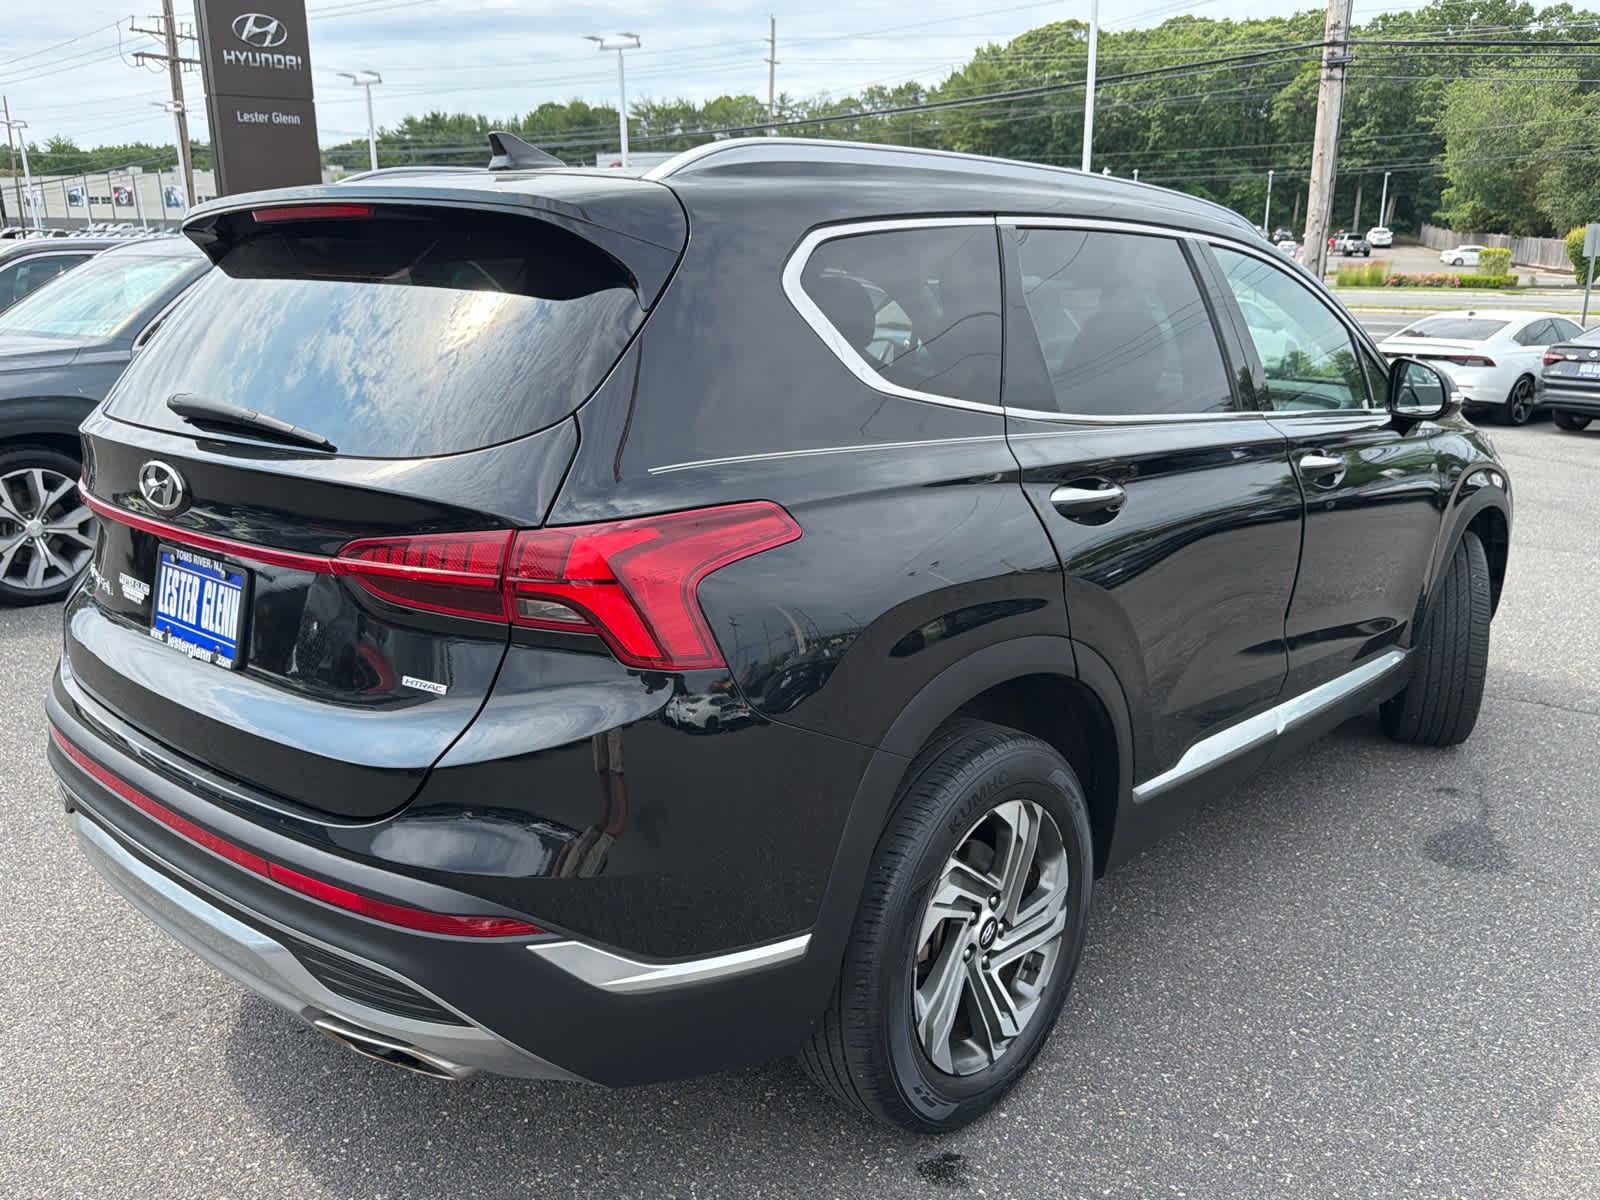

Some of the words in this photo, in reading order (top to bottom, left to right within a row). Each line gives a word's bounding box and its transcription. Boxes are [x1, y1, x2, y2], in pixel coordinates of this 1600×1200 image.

[223, 49, 302, 71] HYUNDAI
[236, 110, 269, 124] Lester
[271, 112, 301, 125] Glenn
[175, 549, 193, 563] TOMS
[158, 565, 200, 626] LESTER
[200, 579, 241, 641] GLENN
[167, 633, 212, 663] lesterglenn
[404, 678, 444, 693] HTRAC
